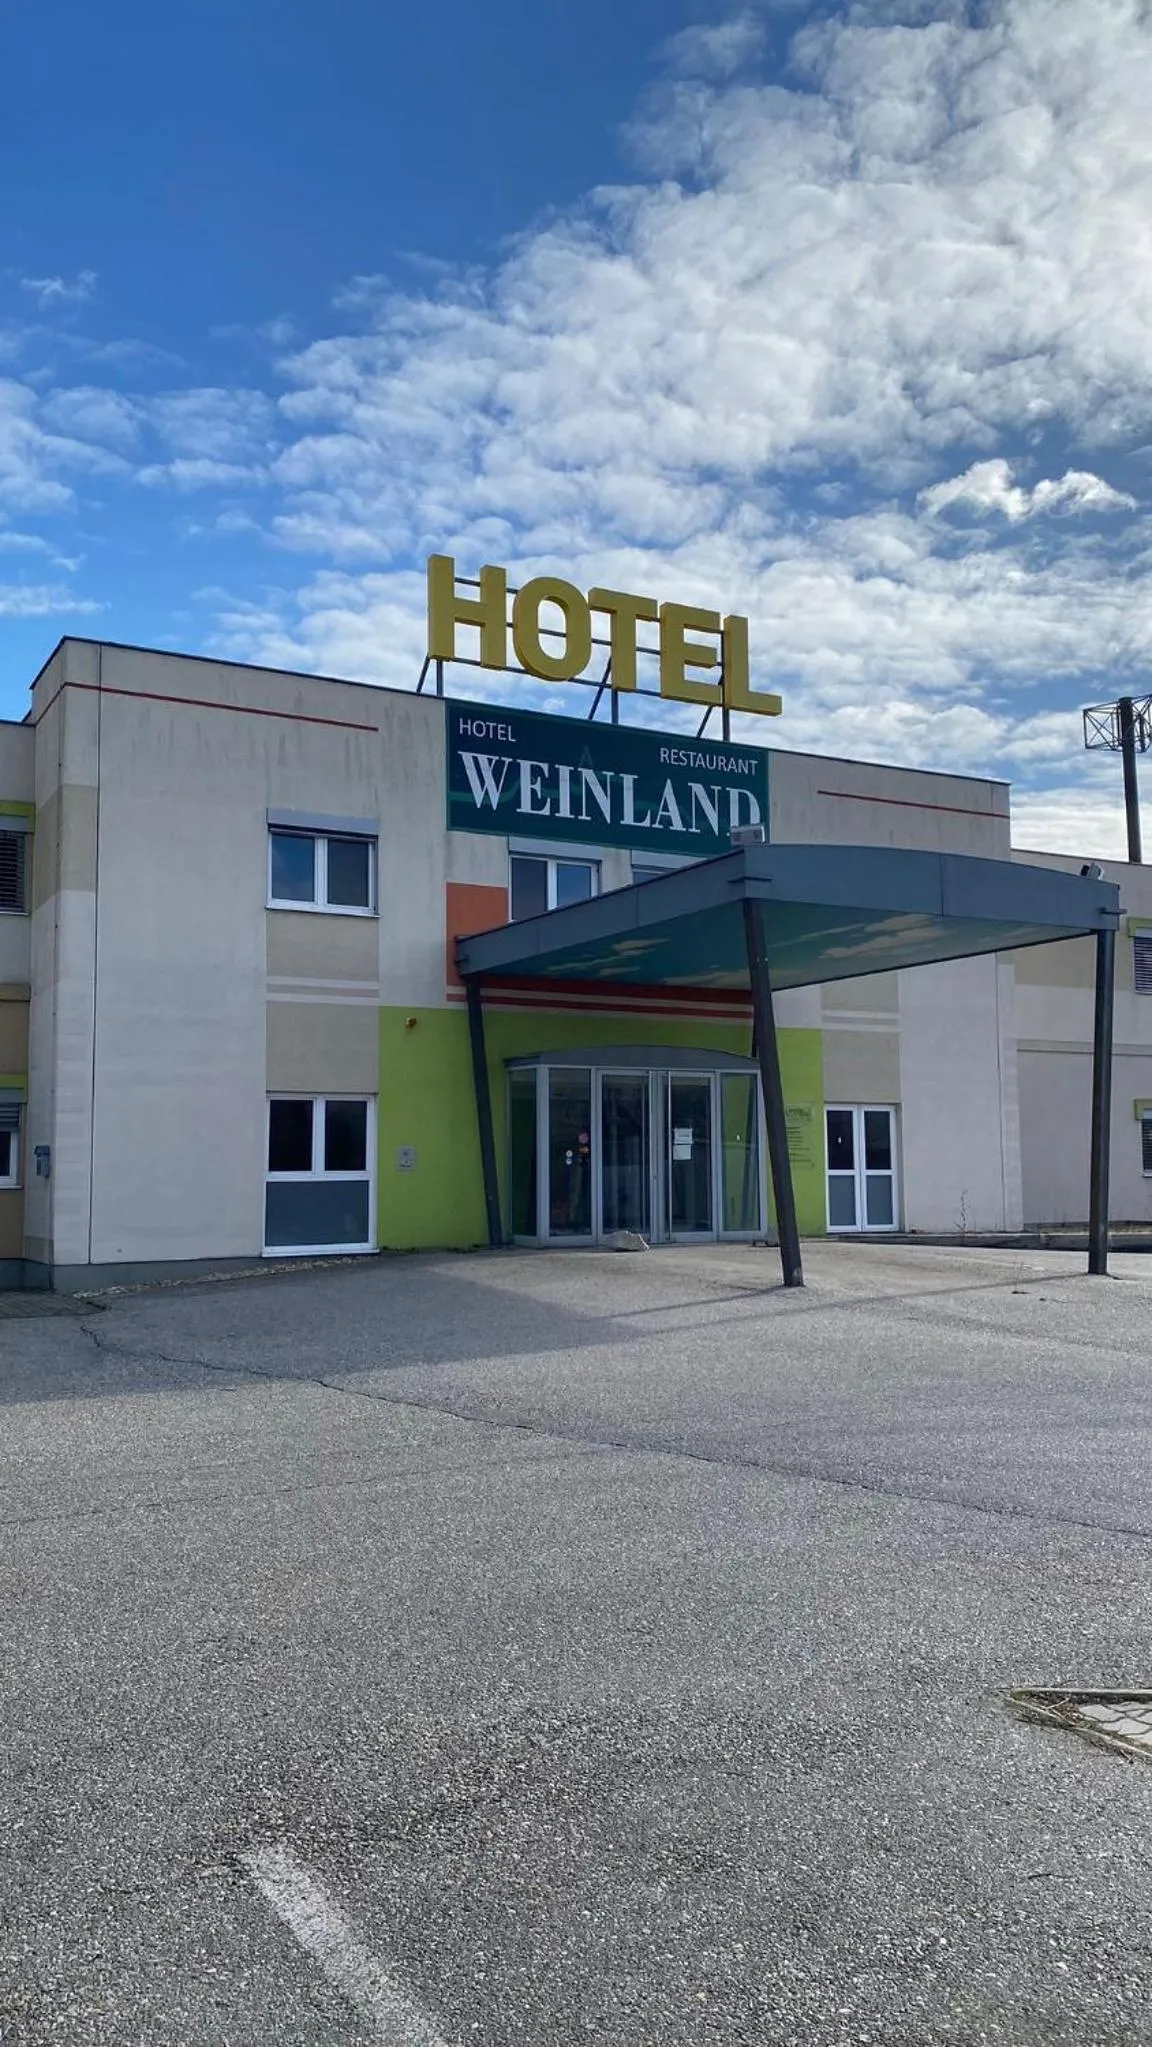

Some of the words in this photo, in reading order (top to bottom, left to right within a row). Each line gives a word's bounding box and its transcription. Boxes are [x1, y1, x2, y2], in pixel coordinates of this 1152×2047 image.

[428, 554, 782, 716] HOTEL
[459, 718, 516, 742] HOTEL
[660, 748, 758, 775] RESTAURANT
[458, 751, 761, 837] WEINLAND
